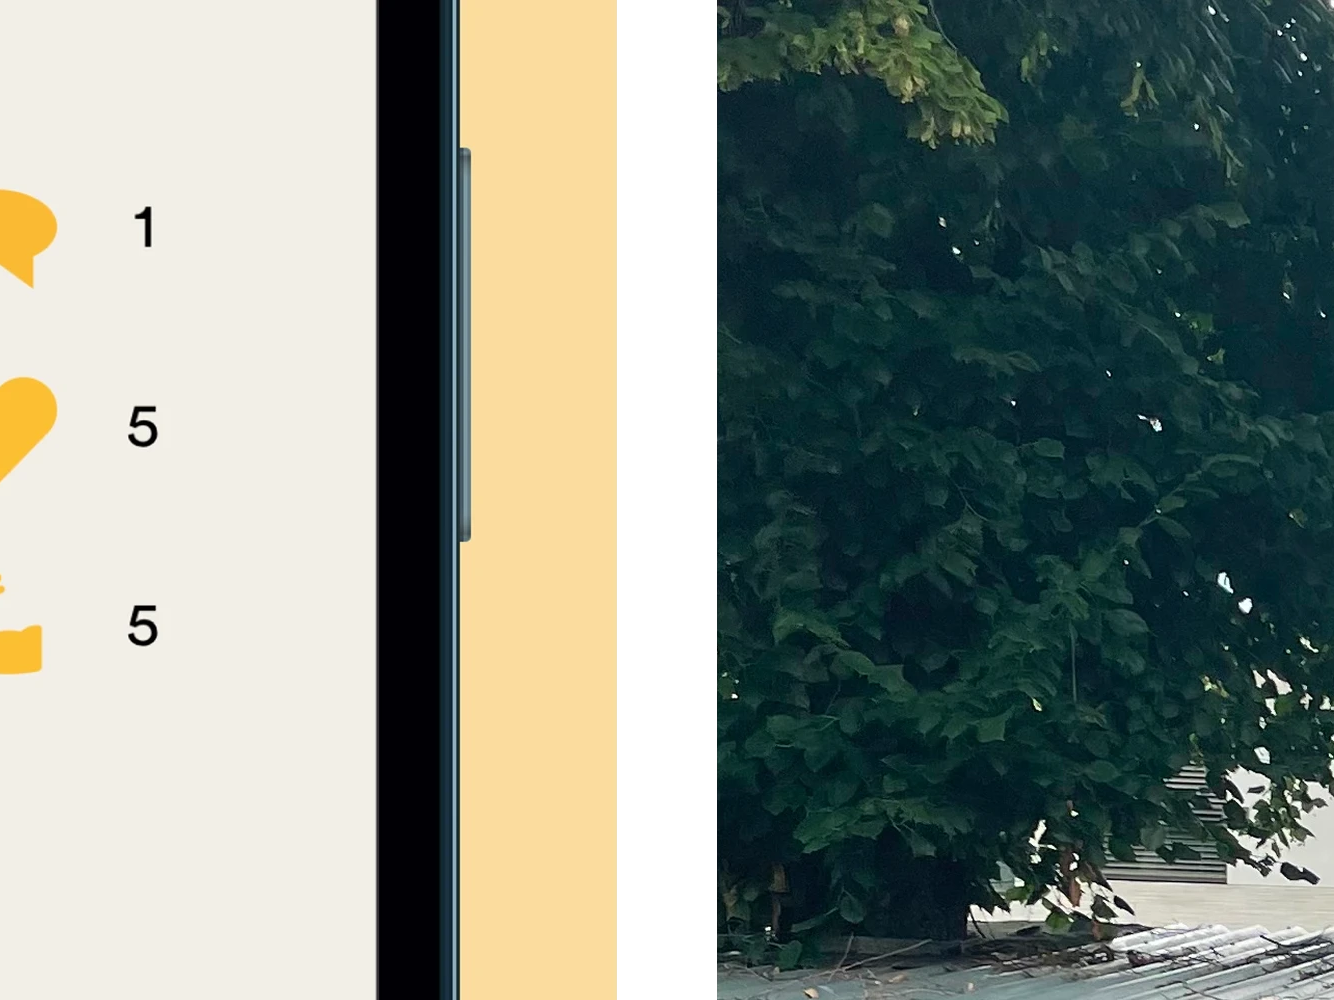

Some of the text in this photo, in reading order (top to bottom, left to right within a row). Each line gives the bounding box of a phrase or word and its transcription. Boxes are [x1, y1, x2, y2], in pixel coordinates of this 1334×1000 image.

[134, 206, 152, 248] 1
[127, 405, 158, 448] 5
[127, 604, 158, 647] 5
